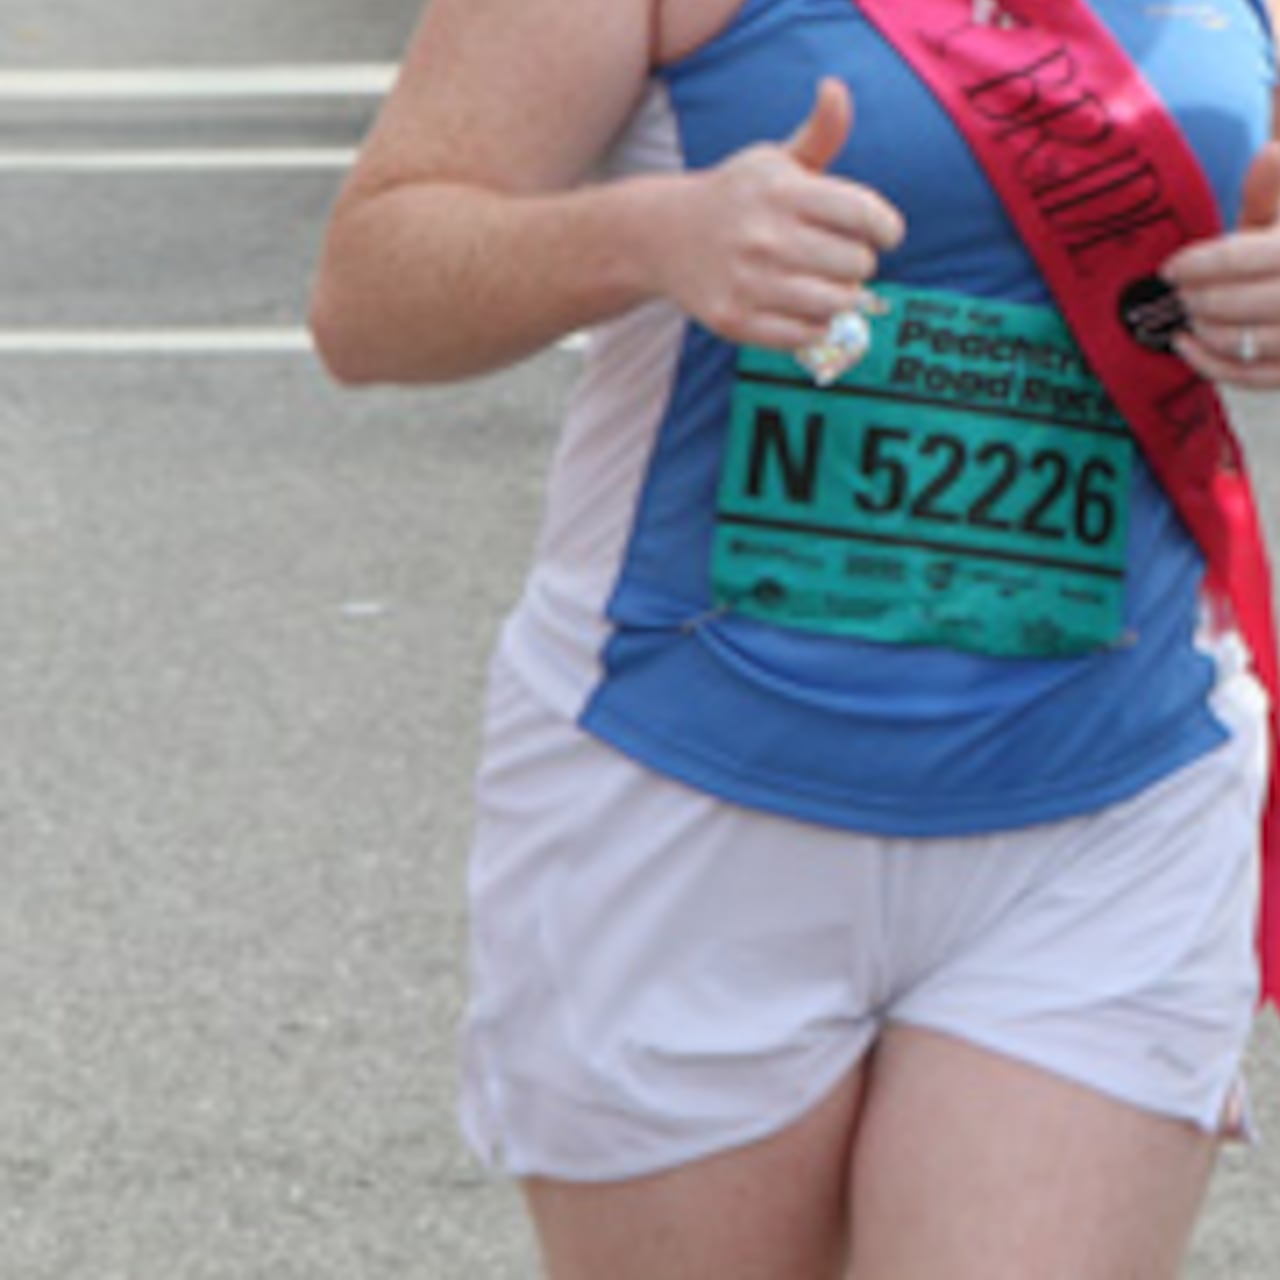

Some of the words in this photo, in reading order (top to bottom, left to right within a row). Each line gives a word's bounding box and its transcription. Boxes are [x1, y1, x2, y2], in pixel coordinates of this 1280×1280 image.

[963, 42, 1182, 278] BRIDE
[887, 356, 1014, 402] Road
[742, 405, 824, 505] N
[853, 426, 1117, 547] 52226
